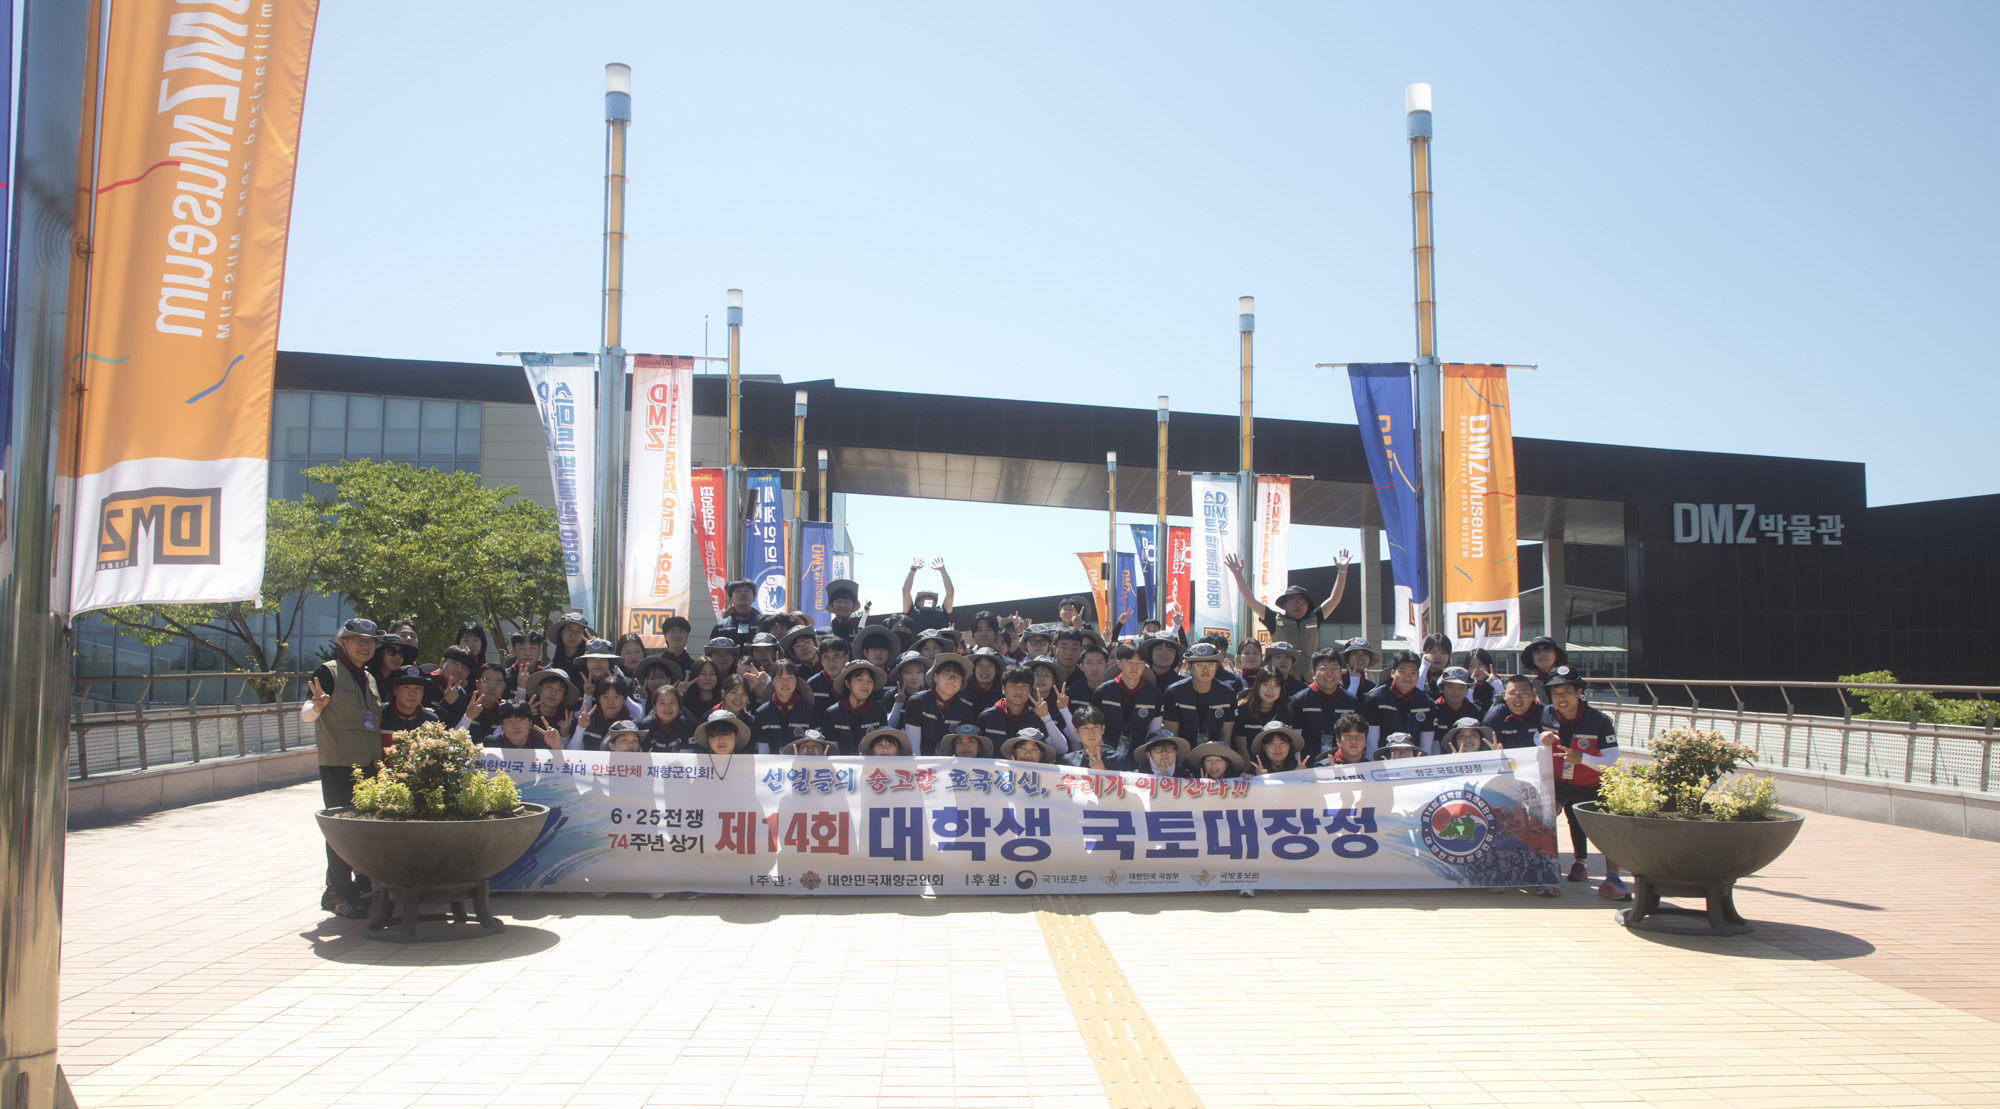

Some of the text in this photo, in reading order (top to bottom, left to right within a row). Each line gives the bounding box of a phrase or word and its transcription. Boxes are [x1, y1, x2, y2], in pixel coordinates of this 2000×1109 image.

[1215, 490, 1228, 535] DMZ
[1271, 491, 1281, 534] DMZ
[1461, 517, 1469, 558] MUSEUM
[1461, 614, 1503, 635] DMZ
[591, 764, 643, 779] 안보단체
[646, 765, 714, 780] 재향군인회!
[1436, 763, 1483, 776] 국토대장정
[762, 767, 854, 794] 선열들의
[865, 767, 936, 793] 숭고한
[945, 768, 1048, 796] 호국정신,
[1056, 773, 1126, 797] 우리가
[607, 833, 705, 854] 74주년 상기
[714, 805, 1380, 863] 제14회 대학생 국토대장정
[827, 874, 944, 887] 대한민국재향군인회
[1042, 873, 1088, 885] 국가보훈부
[1129, 872, 1179, 880] 대한민국 국방부
